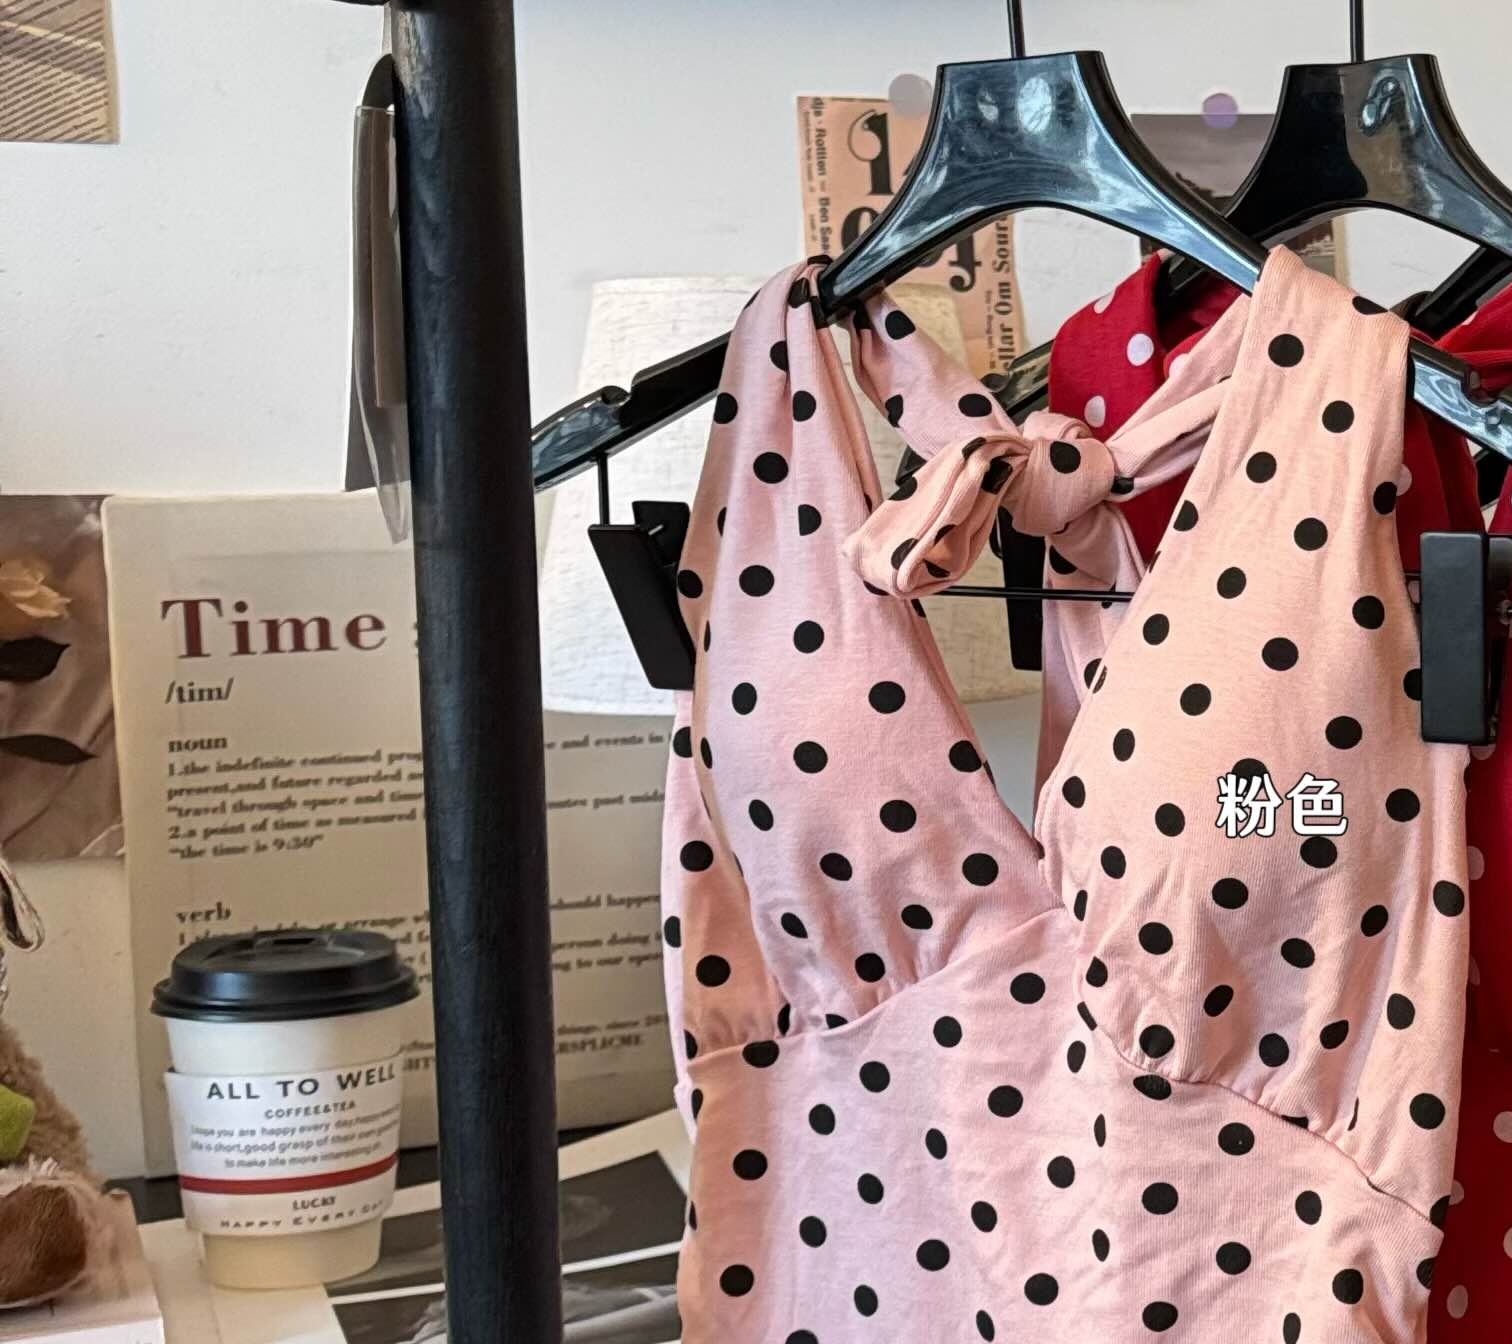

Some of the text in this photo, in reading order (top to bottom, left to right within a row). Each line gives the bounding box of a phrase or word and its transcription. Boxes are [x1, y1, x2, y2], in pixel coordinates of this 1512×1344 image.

[160, 598, 388, 659] Time
[168, 736, 228, 753] noun
[176, 901, 232, 925] verb
[206, 1082, 261, 1100] ALL
[276, 1078, 320, 1098] TO
[336, 1062, 396, 1092] WELL
[264, 1099, 355, 1120] COFFEE&TEA
